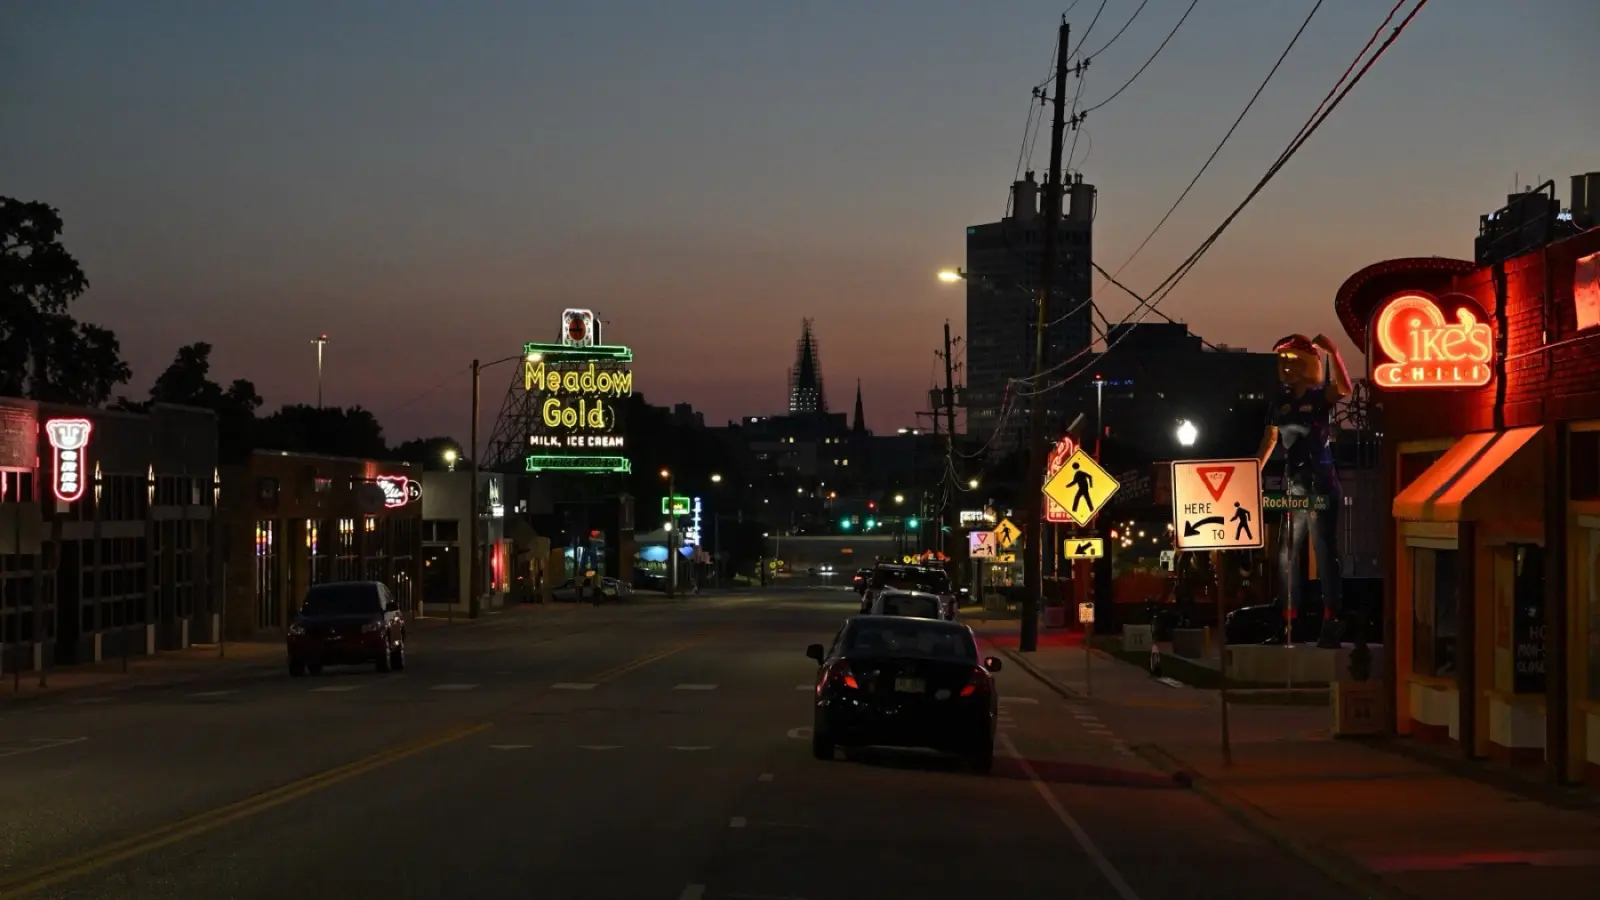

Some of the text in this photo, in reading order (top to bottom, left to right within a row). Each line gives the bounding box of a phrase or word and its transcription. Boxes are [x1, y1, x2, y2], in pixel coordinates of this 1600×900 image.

[524, 361, 633, 394] Meadow
[1389, 365, 1479, 383] CHILI
[542, 398, 605, 428] Gold
[529, 435, 624, 448] MILK, ICE CREAM
[1184, 502, 1213, 515] HERE
[1262, 496, 1309, 508] Rockford
[1212, 529, 1225, 541] TO
